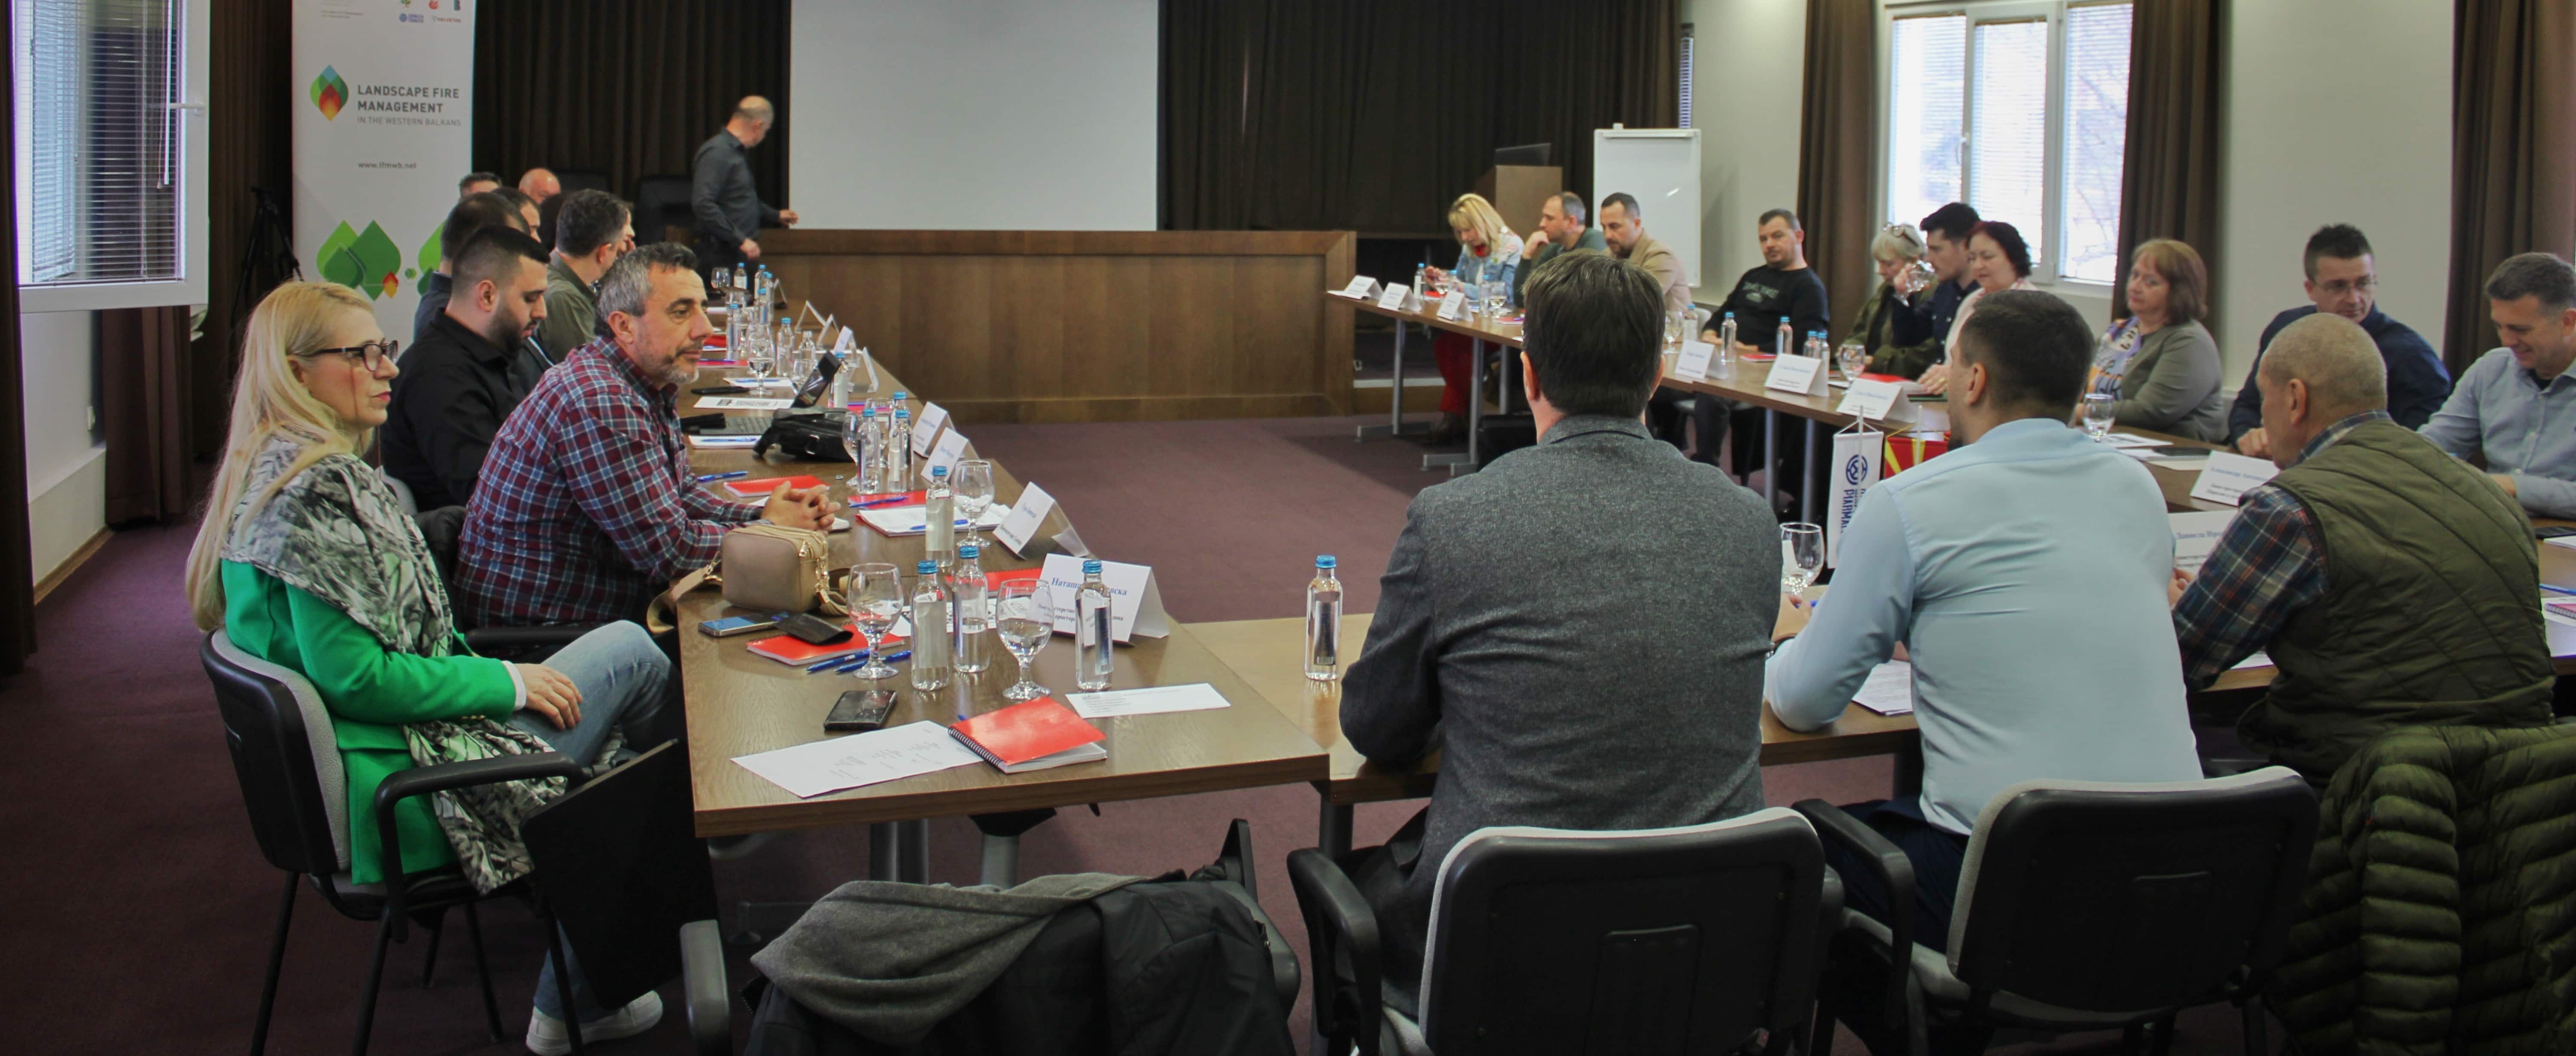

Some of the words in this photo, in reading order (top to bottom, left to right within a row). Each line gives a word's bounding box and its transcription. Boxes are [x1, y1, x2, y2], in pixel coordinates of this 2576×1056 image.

[358, 85, 428, 97] LANDSCAPE
[433, 88, 459, 98] FIRE
[358, 100, 443, 113] MANAGEMENT
[385, 117, 423, 125] WESTERN
